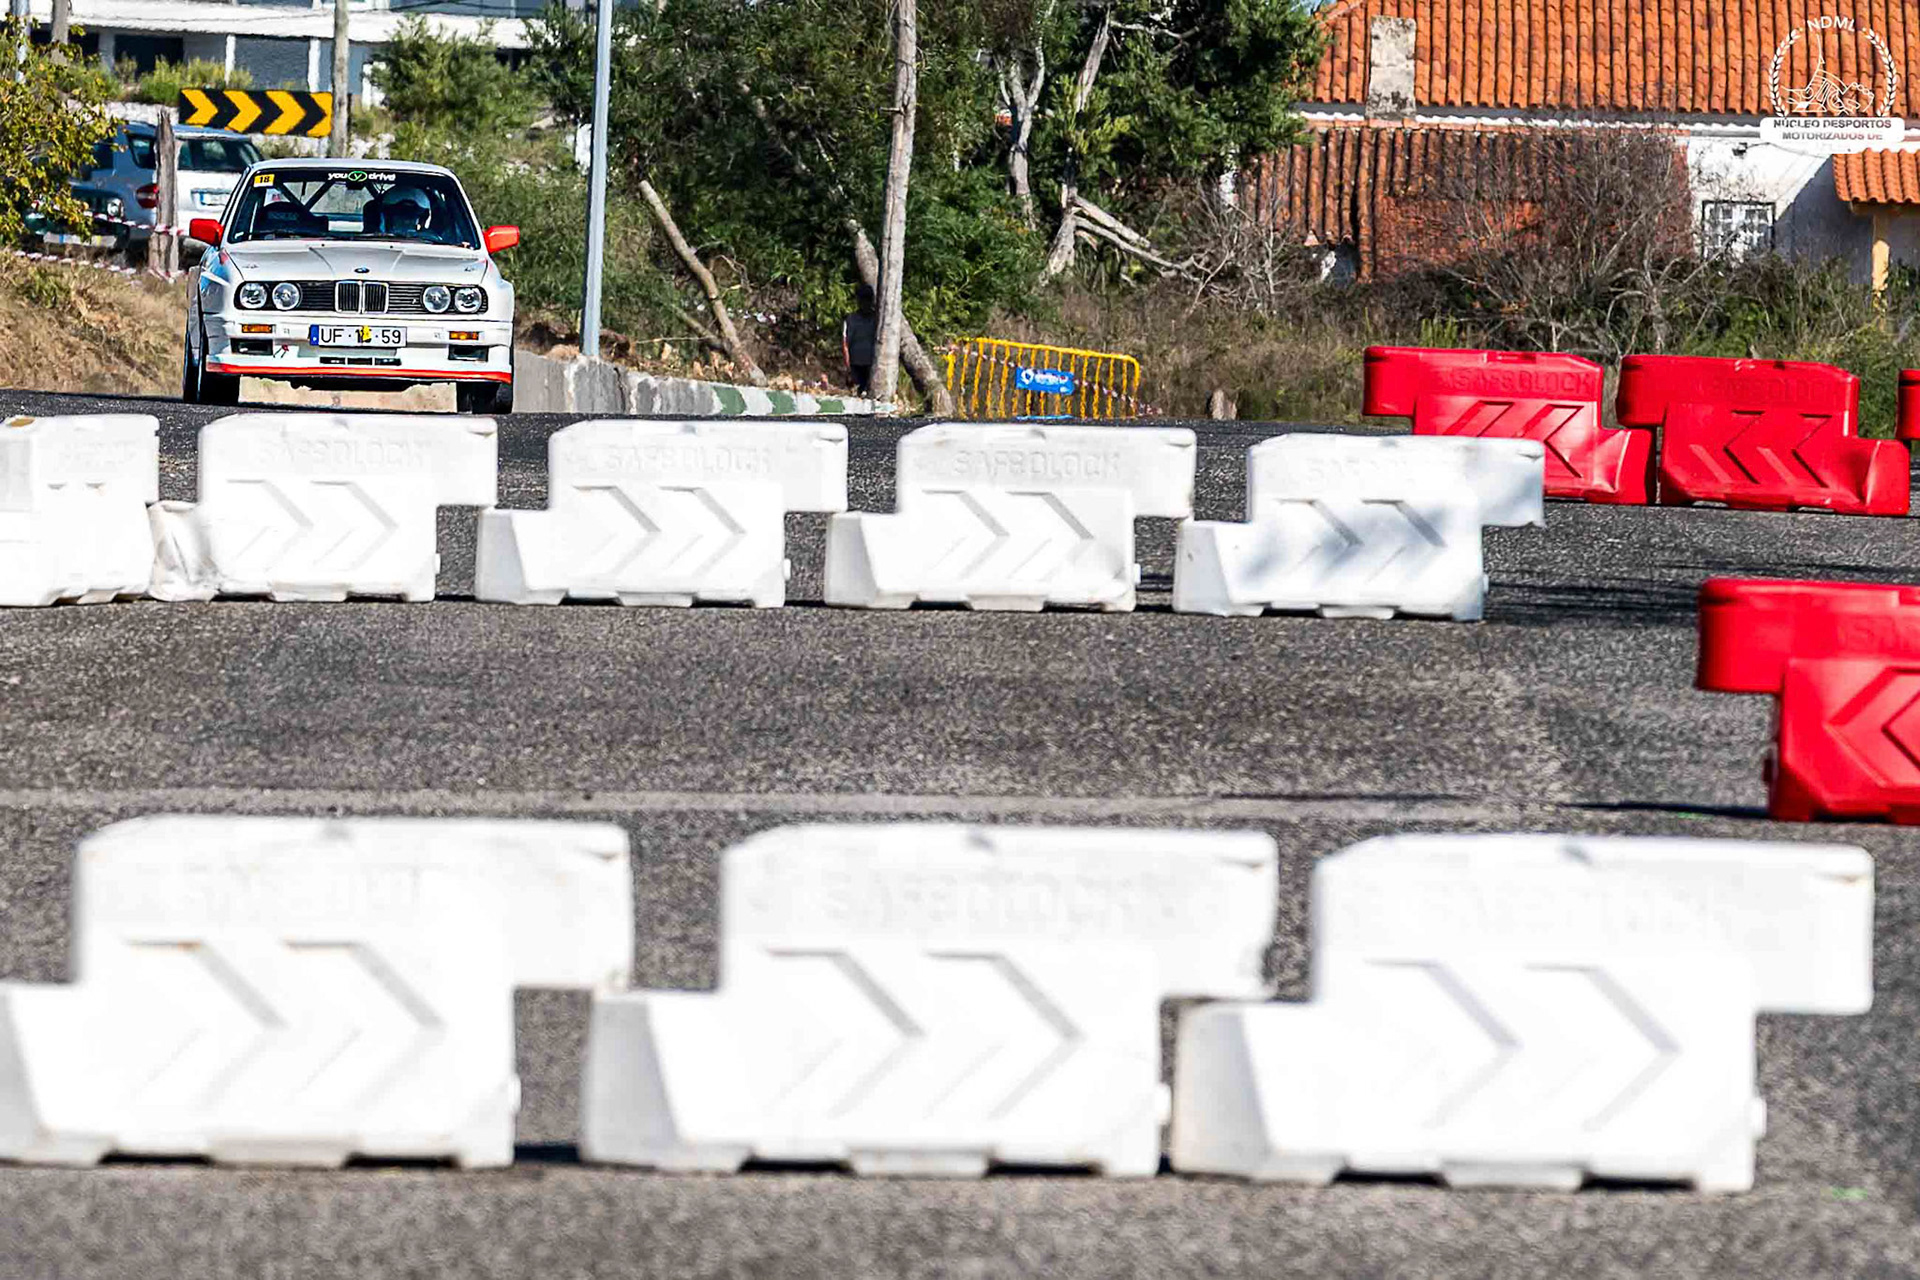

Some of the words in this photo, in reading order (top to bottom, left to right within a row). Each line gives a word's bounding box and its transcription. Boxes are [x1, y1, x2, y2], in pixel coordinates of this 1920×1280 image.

[259, 175, 270, 184] 18
[327, 172, 348, 181] you
[320, 328, 344, 343] UF
[381, 329, 401, 344] 59
